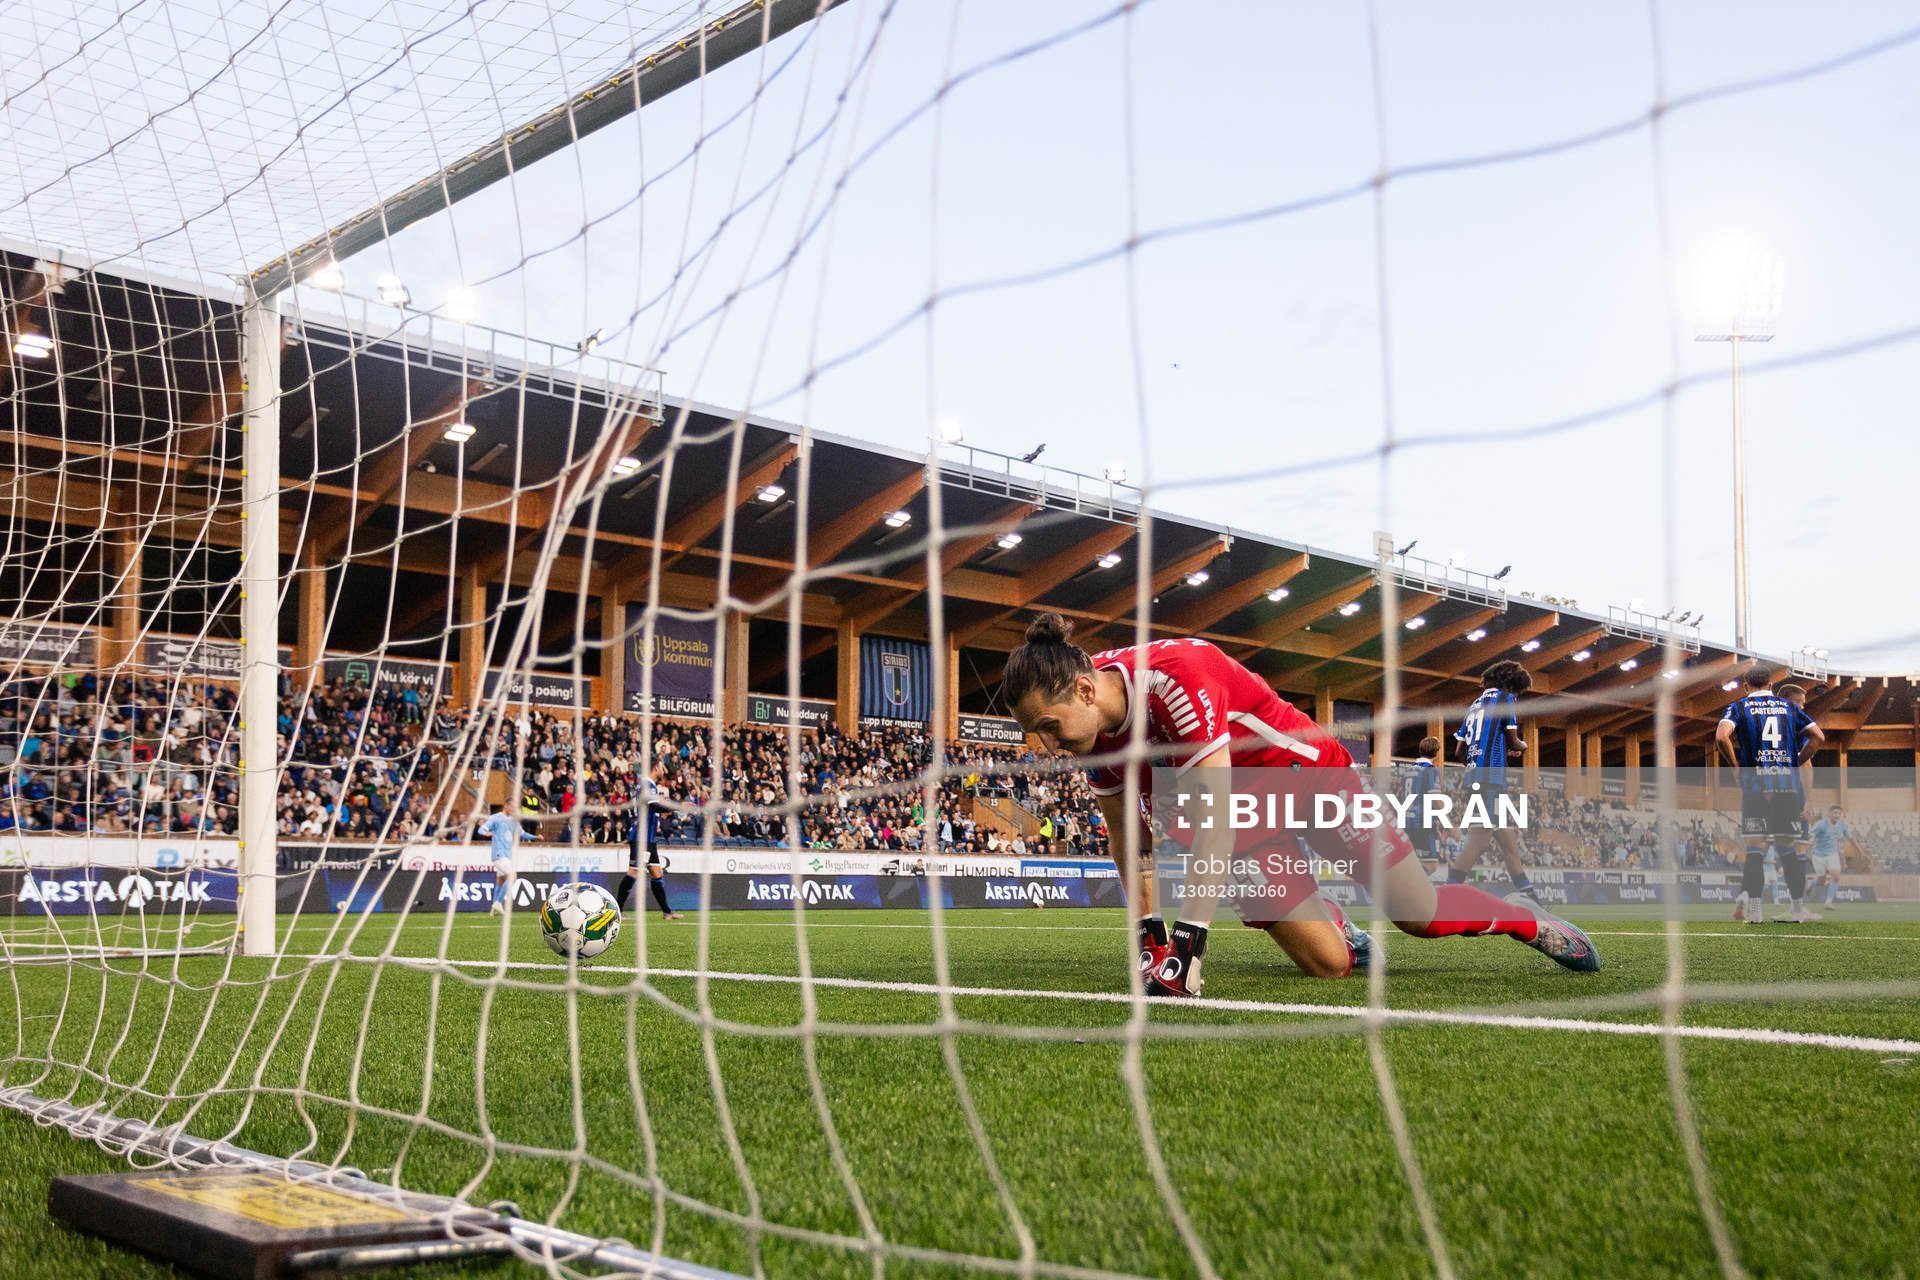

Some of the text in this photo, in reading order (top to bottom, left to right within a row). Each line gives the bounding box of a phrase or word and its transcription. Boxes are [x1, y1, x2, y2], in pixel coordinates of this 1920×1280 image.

[662, 634, 709, 653] Uppsala
[663, 649, 713, 669] kommun
[378, 670, 434, 686] Nu kör vi
[535, 684, 574, 701] poäng!
[659, 698, 716, 714] BILFORUM
[776, 706, 829, 721] Nu ddar vi
[894, 720, 923, 729] match!
[1464, 709, 1485, 745] 31
[1761, 716, 1782, 749] 4
[980, 727, 1023, 741] BILFORUM
[1756, 765, 1792, 776] InkClub
[990, 798, 999, 807] 15
[777, 862, 792, 871] VVS
[825, 859, 870, 873] ByggPartner
[954, 864, 1015, 877] HUMIDUS
[18, 874, 212, 902] ÅRSTA TAK
[437, 877, 494, 901] ÅRST
[747, 880, 855, 900] ÅRSTA TAK
[985, 881, 1070, 900] ÅRSTA TAK
